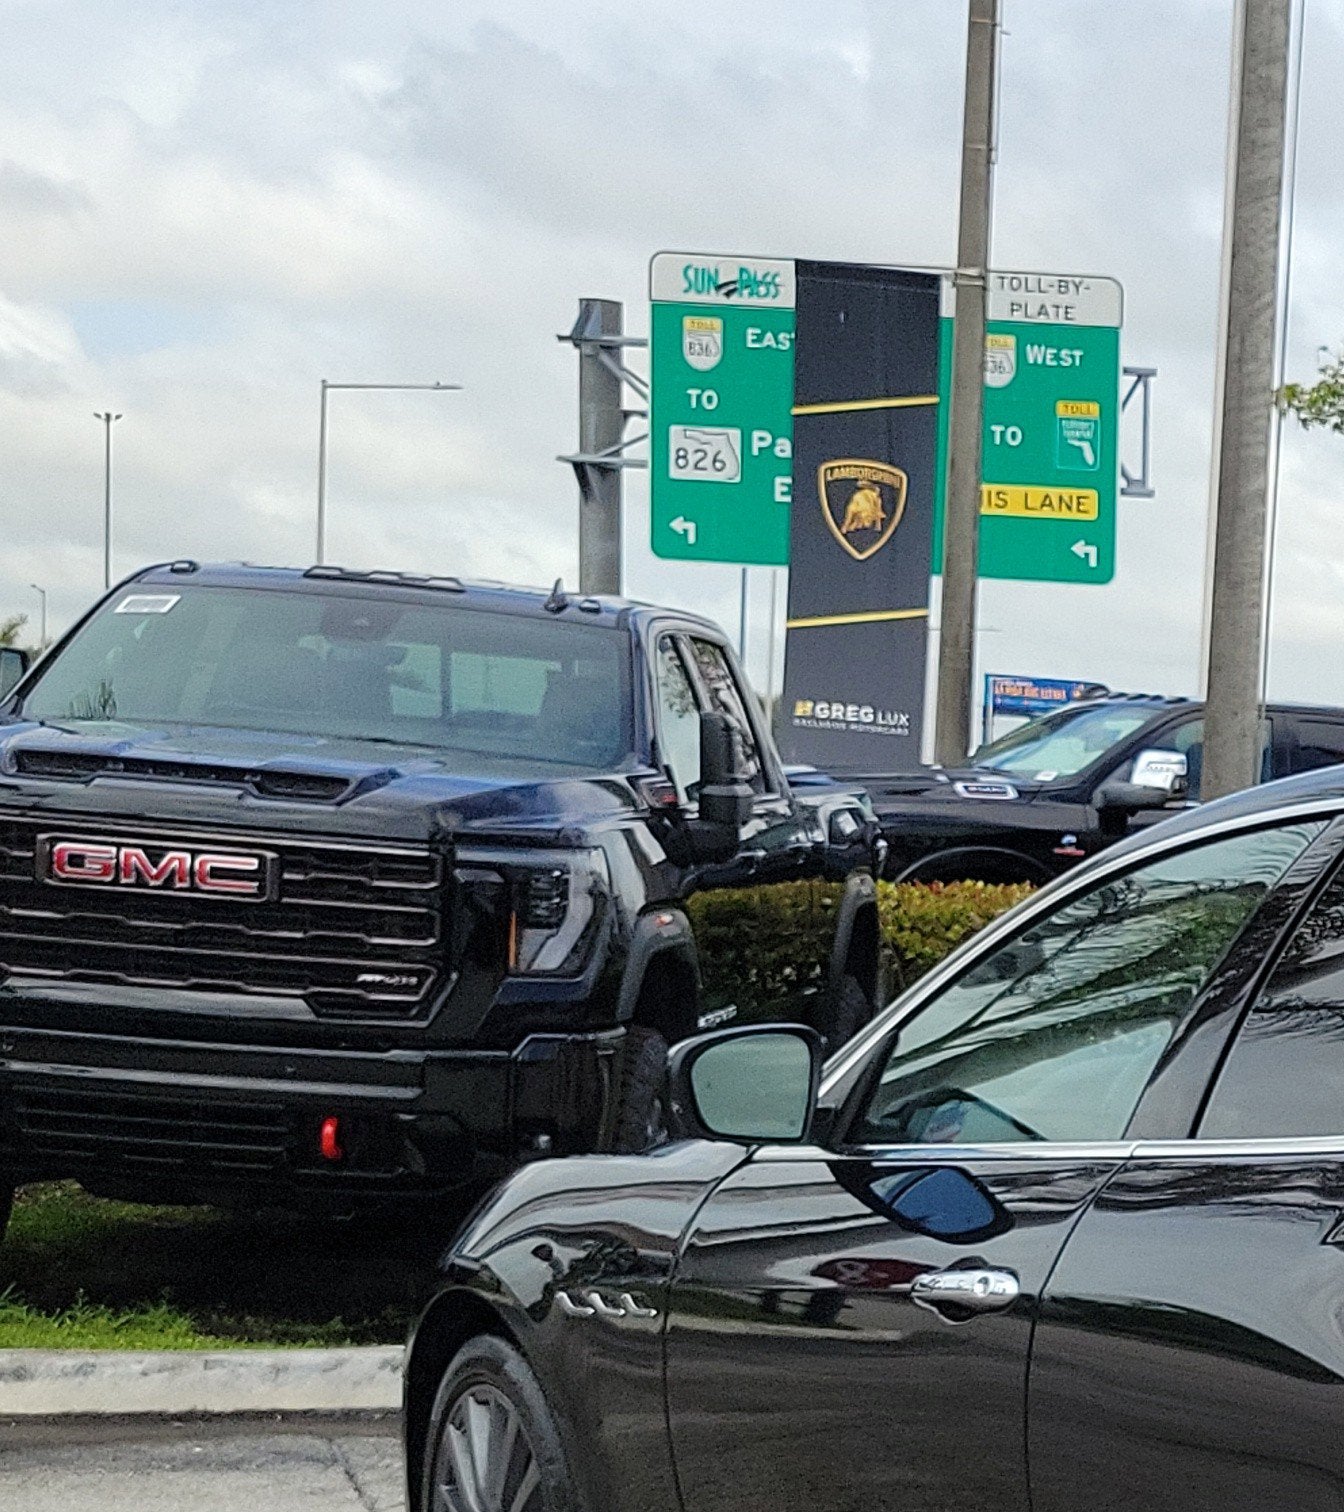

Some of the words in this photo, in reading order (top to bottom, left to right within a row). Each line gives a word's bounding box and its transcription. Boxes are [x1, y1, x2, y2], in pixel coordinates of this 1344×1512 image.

[997, 275, 1092, 296] TOLL-BY-
[1009, 302, 1077, 322] PLATE
[745, 326, 795, 351] EAS
[1025, 344, 1084, 367] WEST
[686, 388, 719, 411] TO
[990, 424, 1023, 447] TO
[674, 447, 727, 473] 826
[1024, 492, 1091, 515] LANE
[876, 710, 910, 727] LUX
[53, 842, 259, 894] GMC
